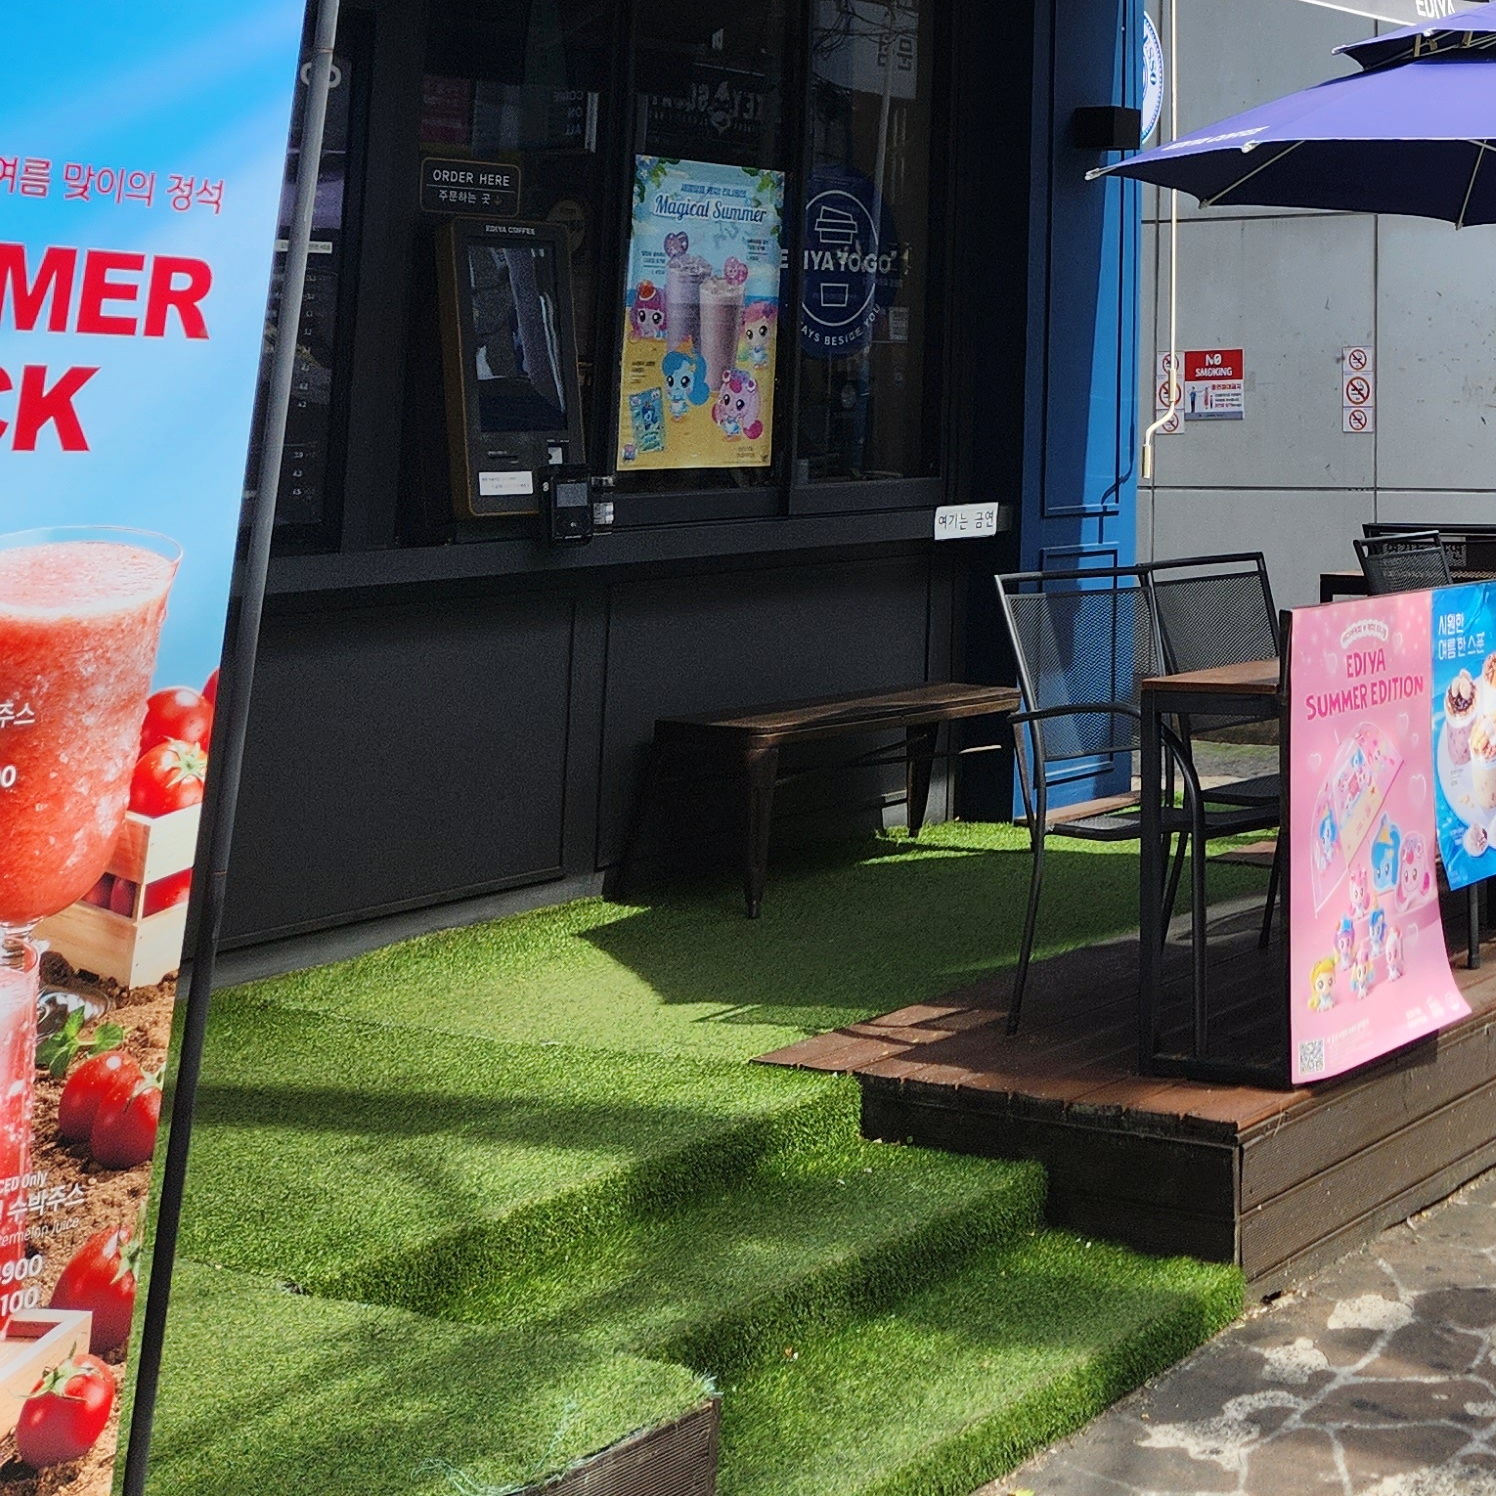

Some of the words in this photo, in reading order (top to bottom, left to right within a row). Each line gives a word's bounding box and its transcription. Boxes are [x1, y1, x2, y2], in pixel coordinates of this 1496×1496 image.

[433, 169, 474, 184] ORDER
[480, 173, 511, 187] HERE
[63, 162, 153, 209] 맞이의
[166, 175, 225, 216] 정석
[439, 189, 477, 205] 주문하는
[482, 193, 491, 205] 곳
[655, 194, 709, 221] Magical
[713, 199, 767, 223] Summer
[824, 325, 863, 346] BESIDE
[1205, 353, 1222, 367] NO
[1195, 367, 1233, 377] SMOKING
[938, 512, 968, 531] 여기는
[975, 510, 994, 529] 금연
[1438, 612, 1465, 636] 시원한
[1438, 637, 1456, 661] 여름
[1346, 648, 1386, 679] EDIYA
[1306, 683, 1368, 721] SUMMER
[1370, 675, 1424, 706] EDITION
[21, 1171, 48, 1191] Only
[7, 1182, 86, 1223] 수박주스
[51, 1217, 80, 1235] Juice
